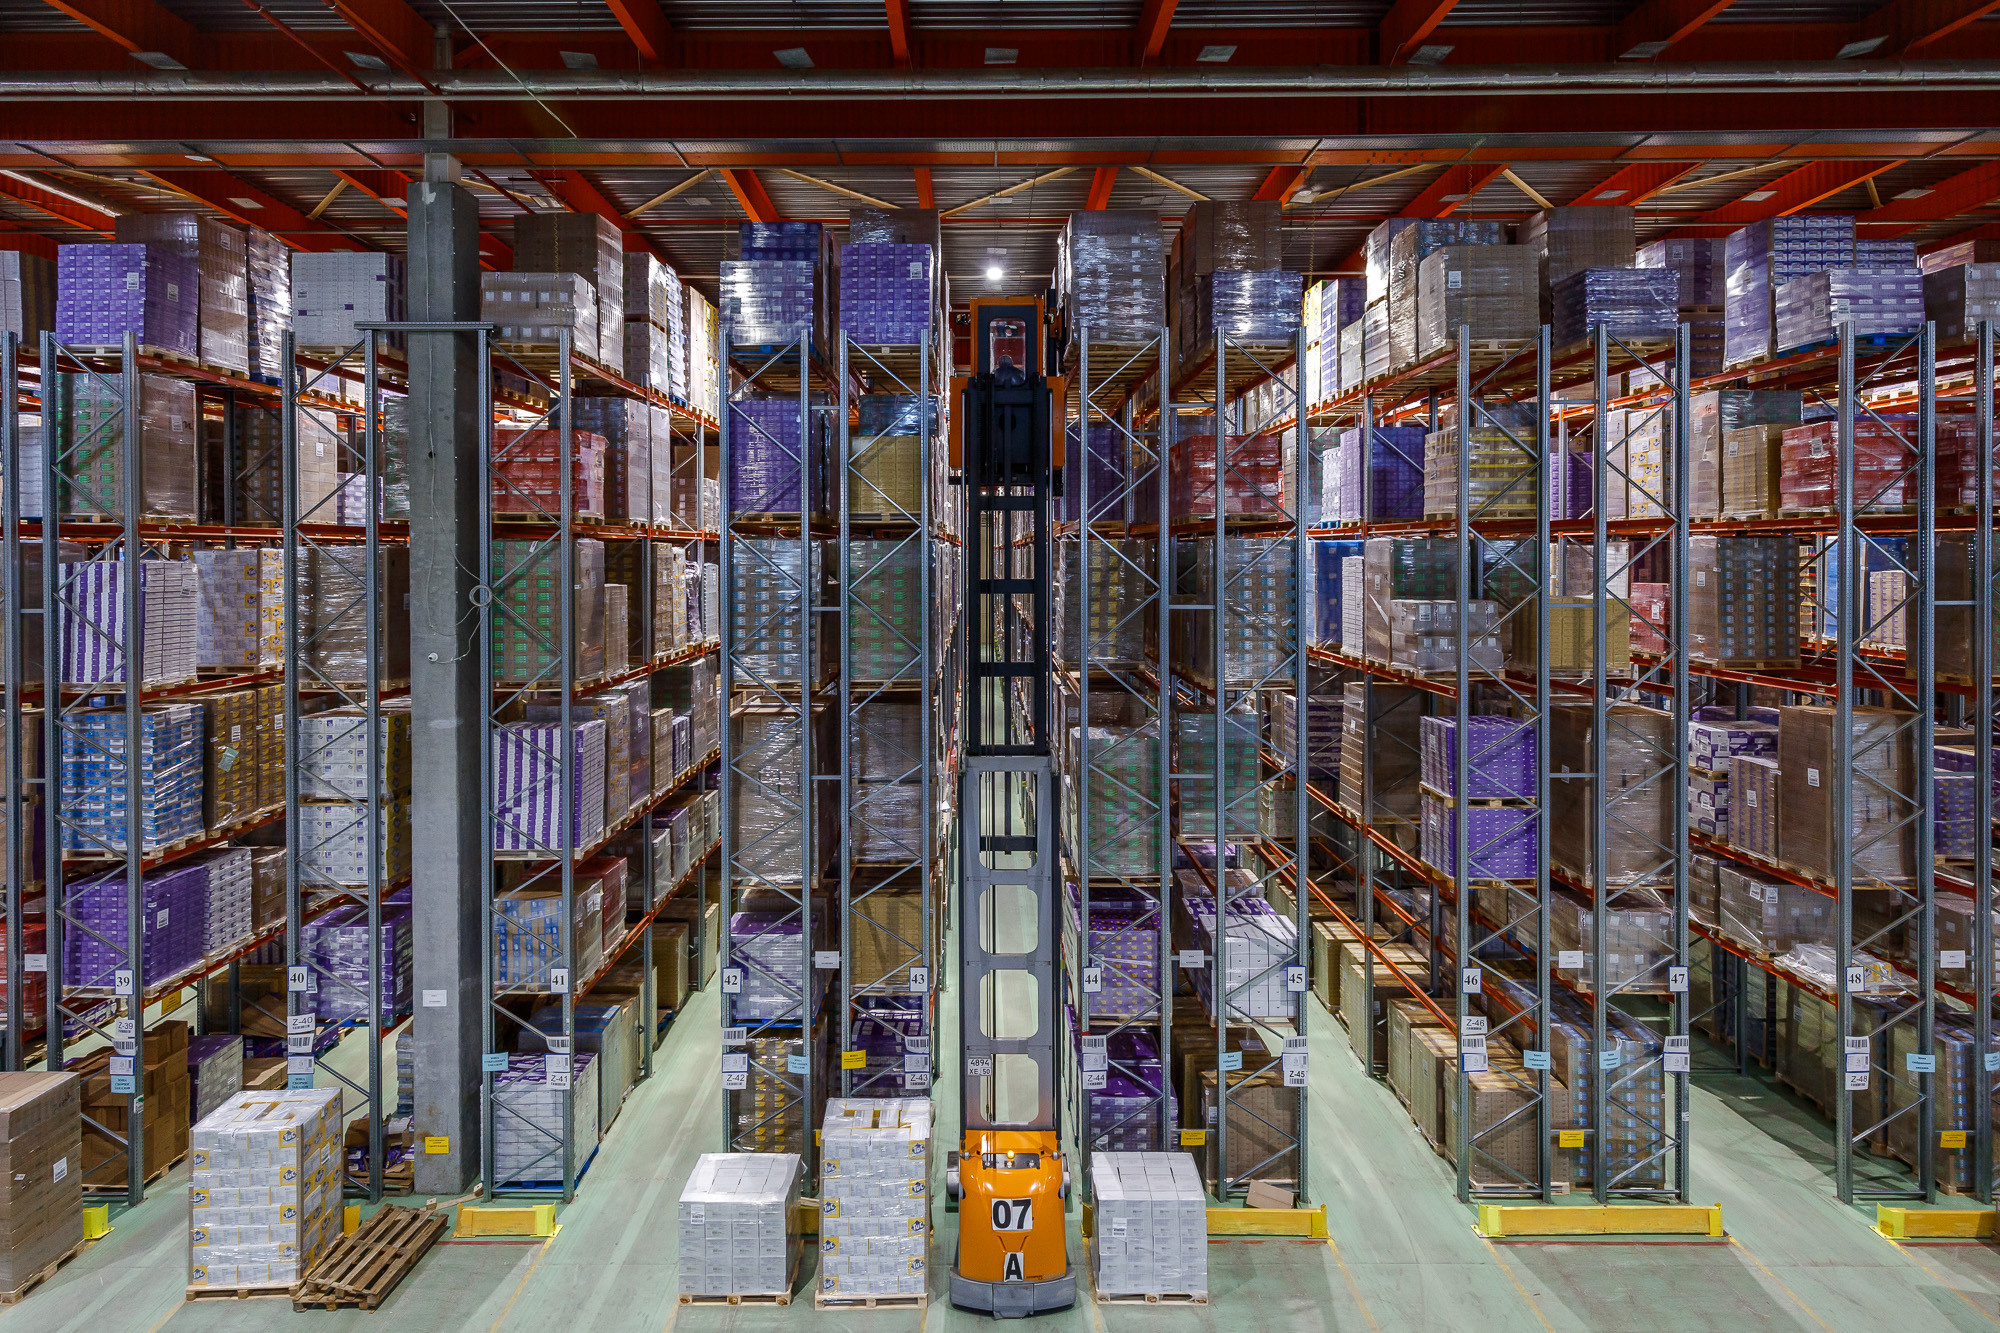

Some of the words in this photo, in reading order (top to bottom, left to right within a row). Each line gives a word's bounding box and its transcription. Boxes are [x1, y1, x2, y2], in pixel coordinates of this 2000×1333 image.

[117, 977, 130, 987] 39
[290, 973, 304, 983] 40
[552, 975, 564, 985] 41
[724, 975, 738, 985] 42
[912, 974, 924, 984] 43
[1085, 974, 1098, 984] 44
[1288, 974, 1302, 984] 45
[1464, 975, 1478, 985] 46
[1671, 974, 1685, 984] 47
[1848, 974, 1861, 984] 48
[292, 1016, 312, 1026] Z-40
[992, 1199, 1031, 1229] 07
[1005, 1253, 1023, 1280] A
